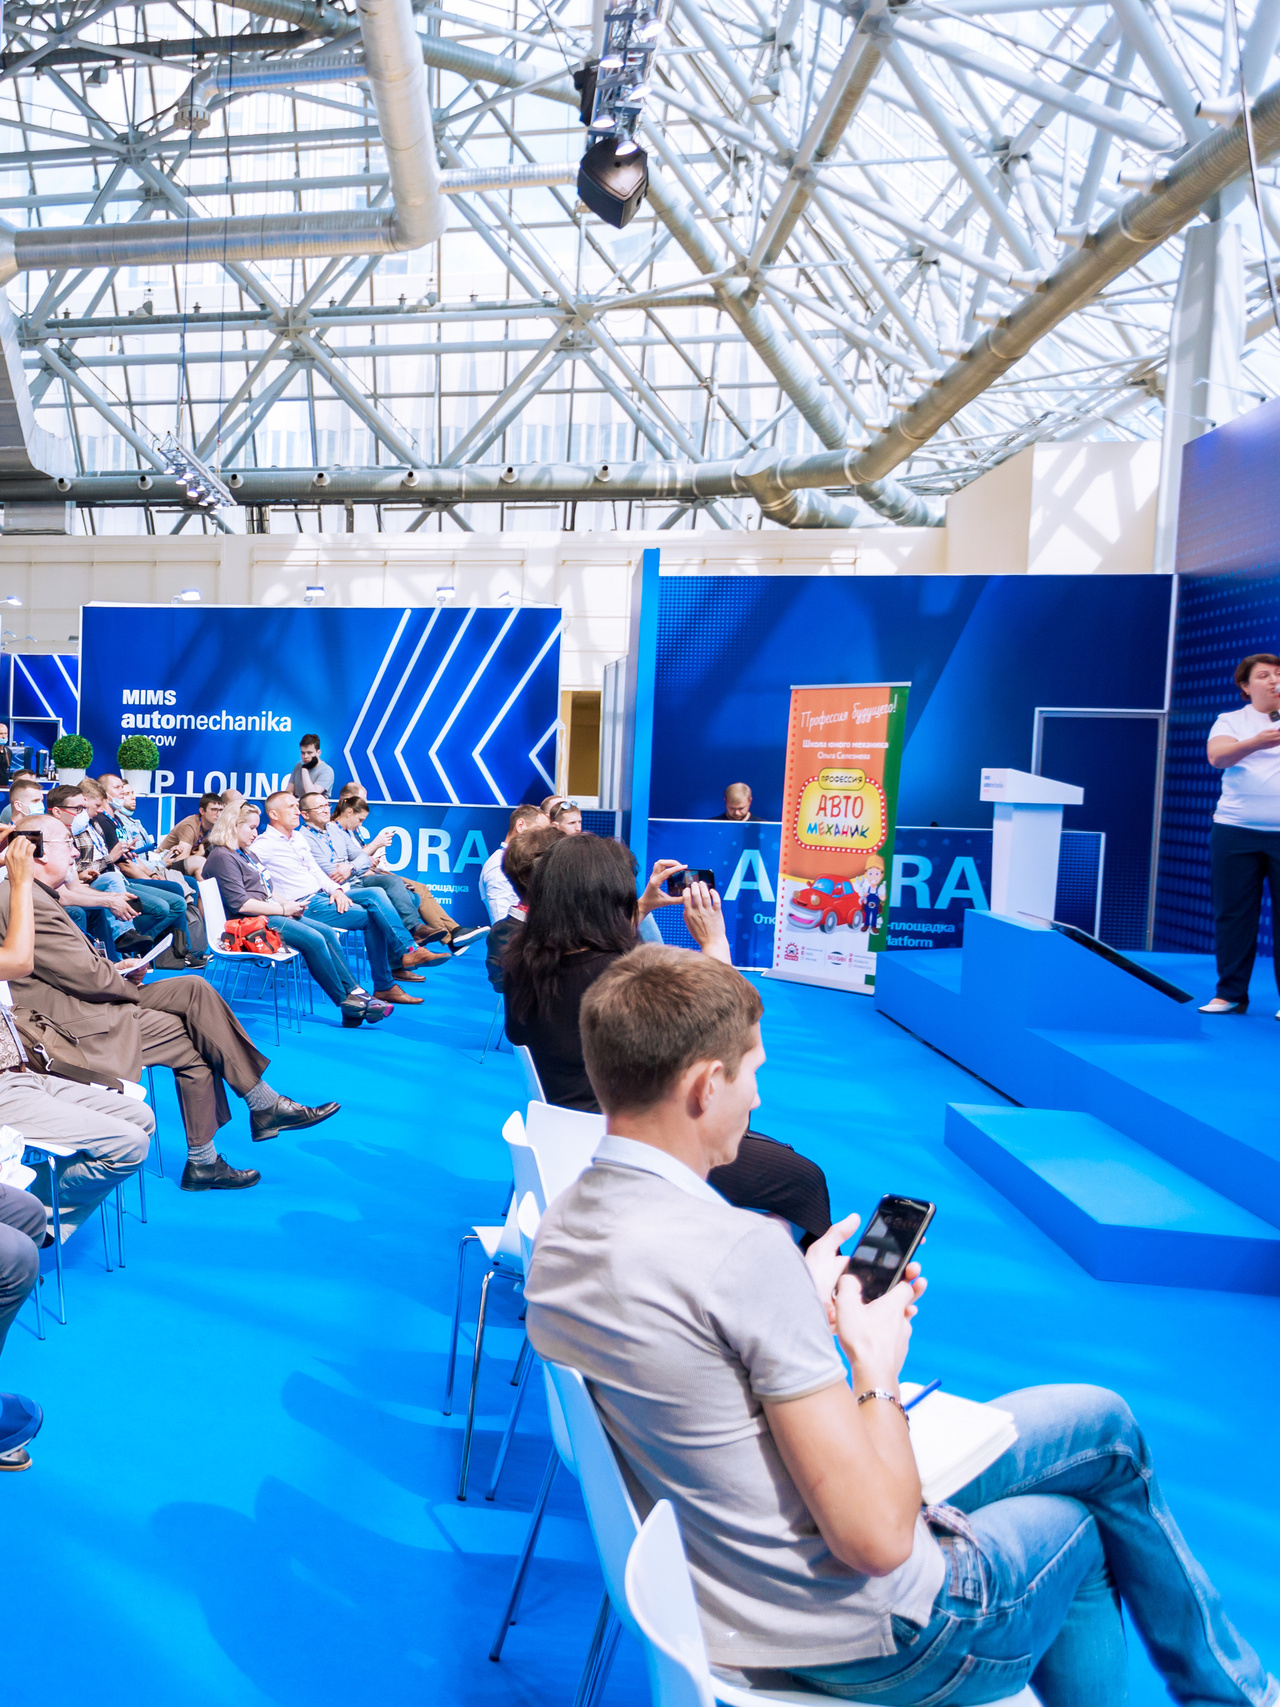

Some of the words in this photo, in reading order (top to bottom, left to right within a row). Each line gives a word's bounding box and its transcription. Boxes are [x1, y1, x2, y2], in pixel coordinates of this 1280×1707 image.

[122, 689, 177, 706] MIMS
[121, 710, 292, 732] automechanika
[801, 710, 849, 733] Профессия
[852, 693, 898, 725] будущего!
[802, 739, 827, 748] Школа
[852, 741, 889, 749] механика
[817, 751, 835, 760] Ольга
[836, 751, 871, 760] Селезнева
[186, 770, 292, 798] LOUN
[821, 775, 863, 784] ПРОФЕССИЯ
[815, 794, 864, 819] АВТО
[806, 822, 869, 838] МЕХАНИК
[886, 934, 933, 948] latform
